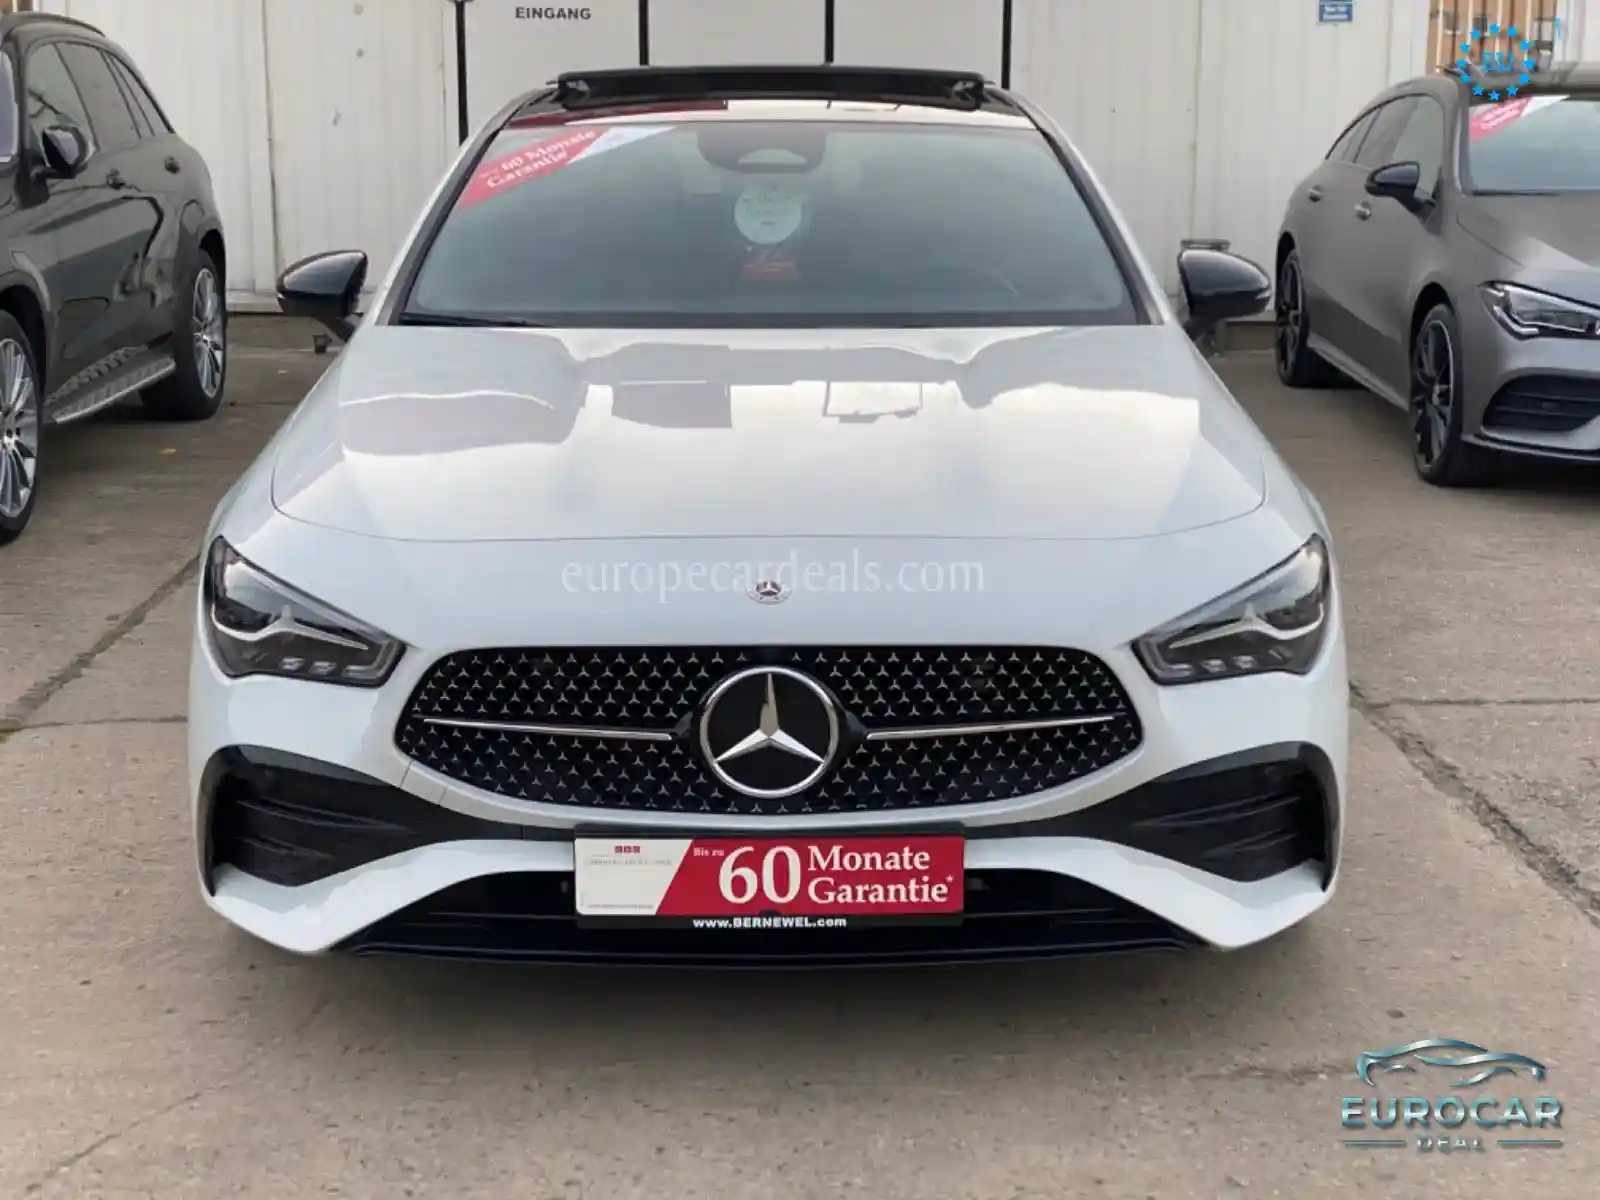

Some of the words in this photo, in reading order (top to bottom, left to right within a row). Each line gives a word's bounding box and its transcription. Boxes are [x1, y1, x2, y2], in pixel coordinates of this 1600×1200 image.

[515, 7, 592, 19] EINGANG
[807, 845, 931, 871] Monate
[718, 846, 802, 904] 60
